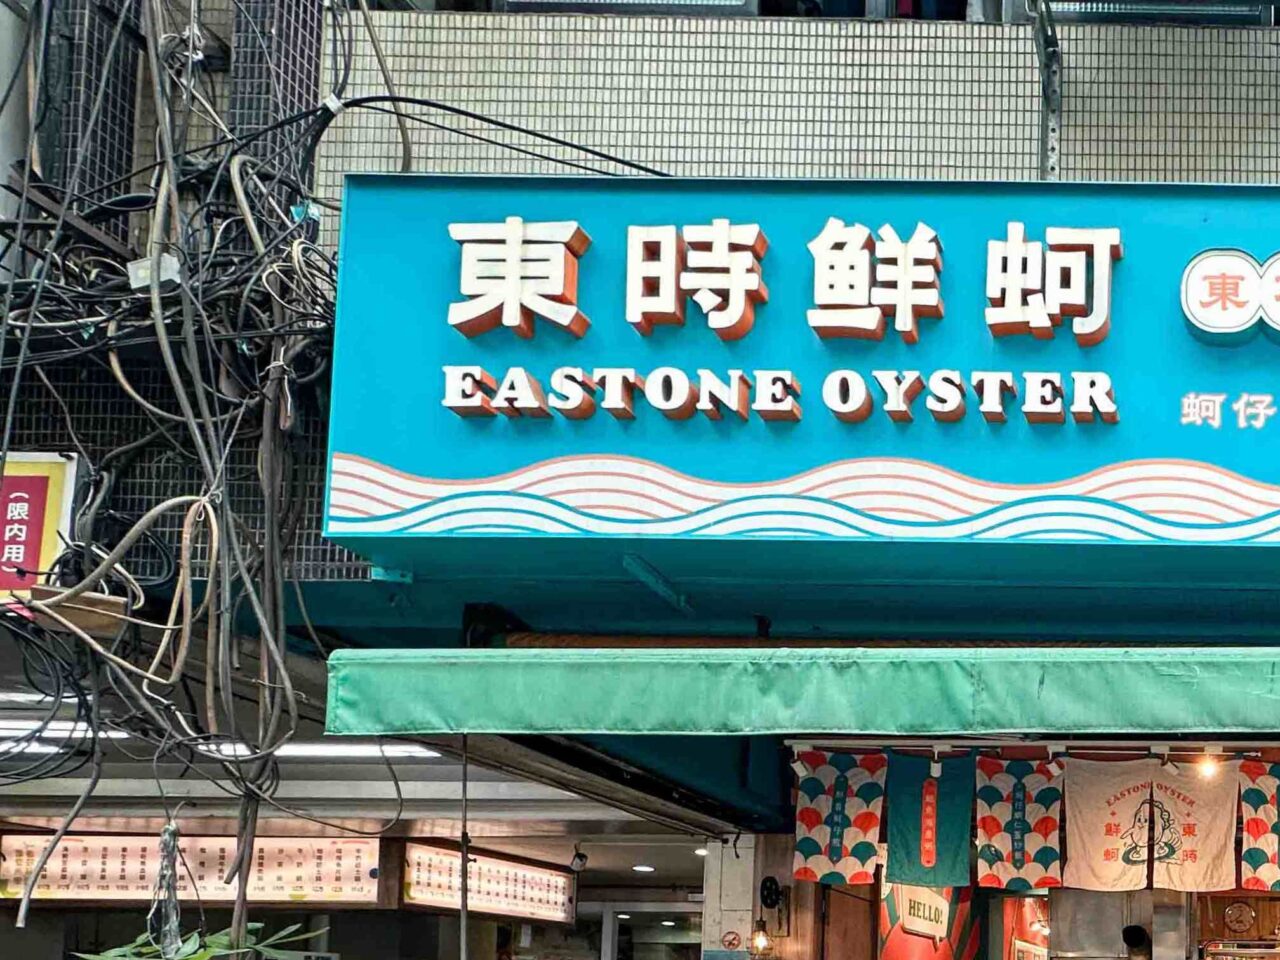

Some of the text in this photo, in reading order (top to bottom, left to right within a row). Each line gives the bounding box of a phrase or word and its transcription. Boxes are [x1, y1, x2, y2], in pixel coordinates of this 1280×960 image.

[446, 215, 1124, 344] 東時鮮蚵
[442, 365, 1119, 423] EASTONE OYSTER
[1155, 782, 1197, 808] OYSTER
[1103, 822, 1122, 862] 鮮蚵
[1181, 822, 1198, 863] 東時
[908, 898, 943, 925] HELLO!
